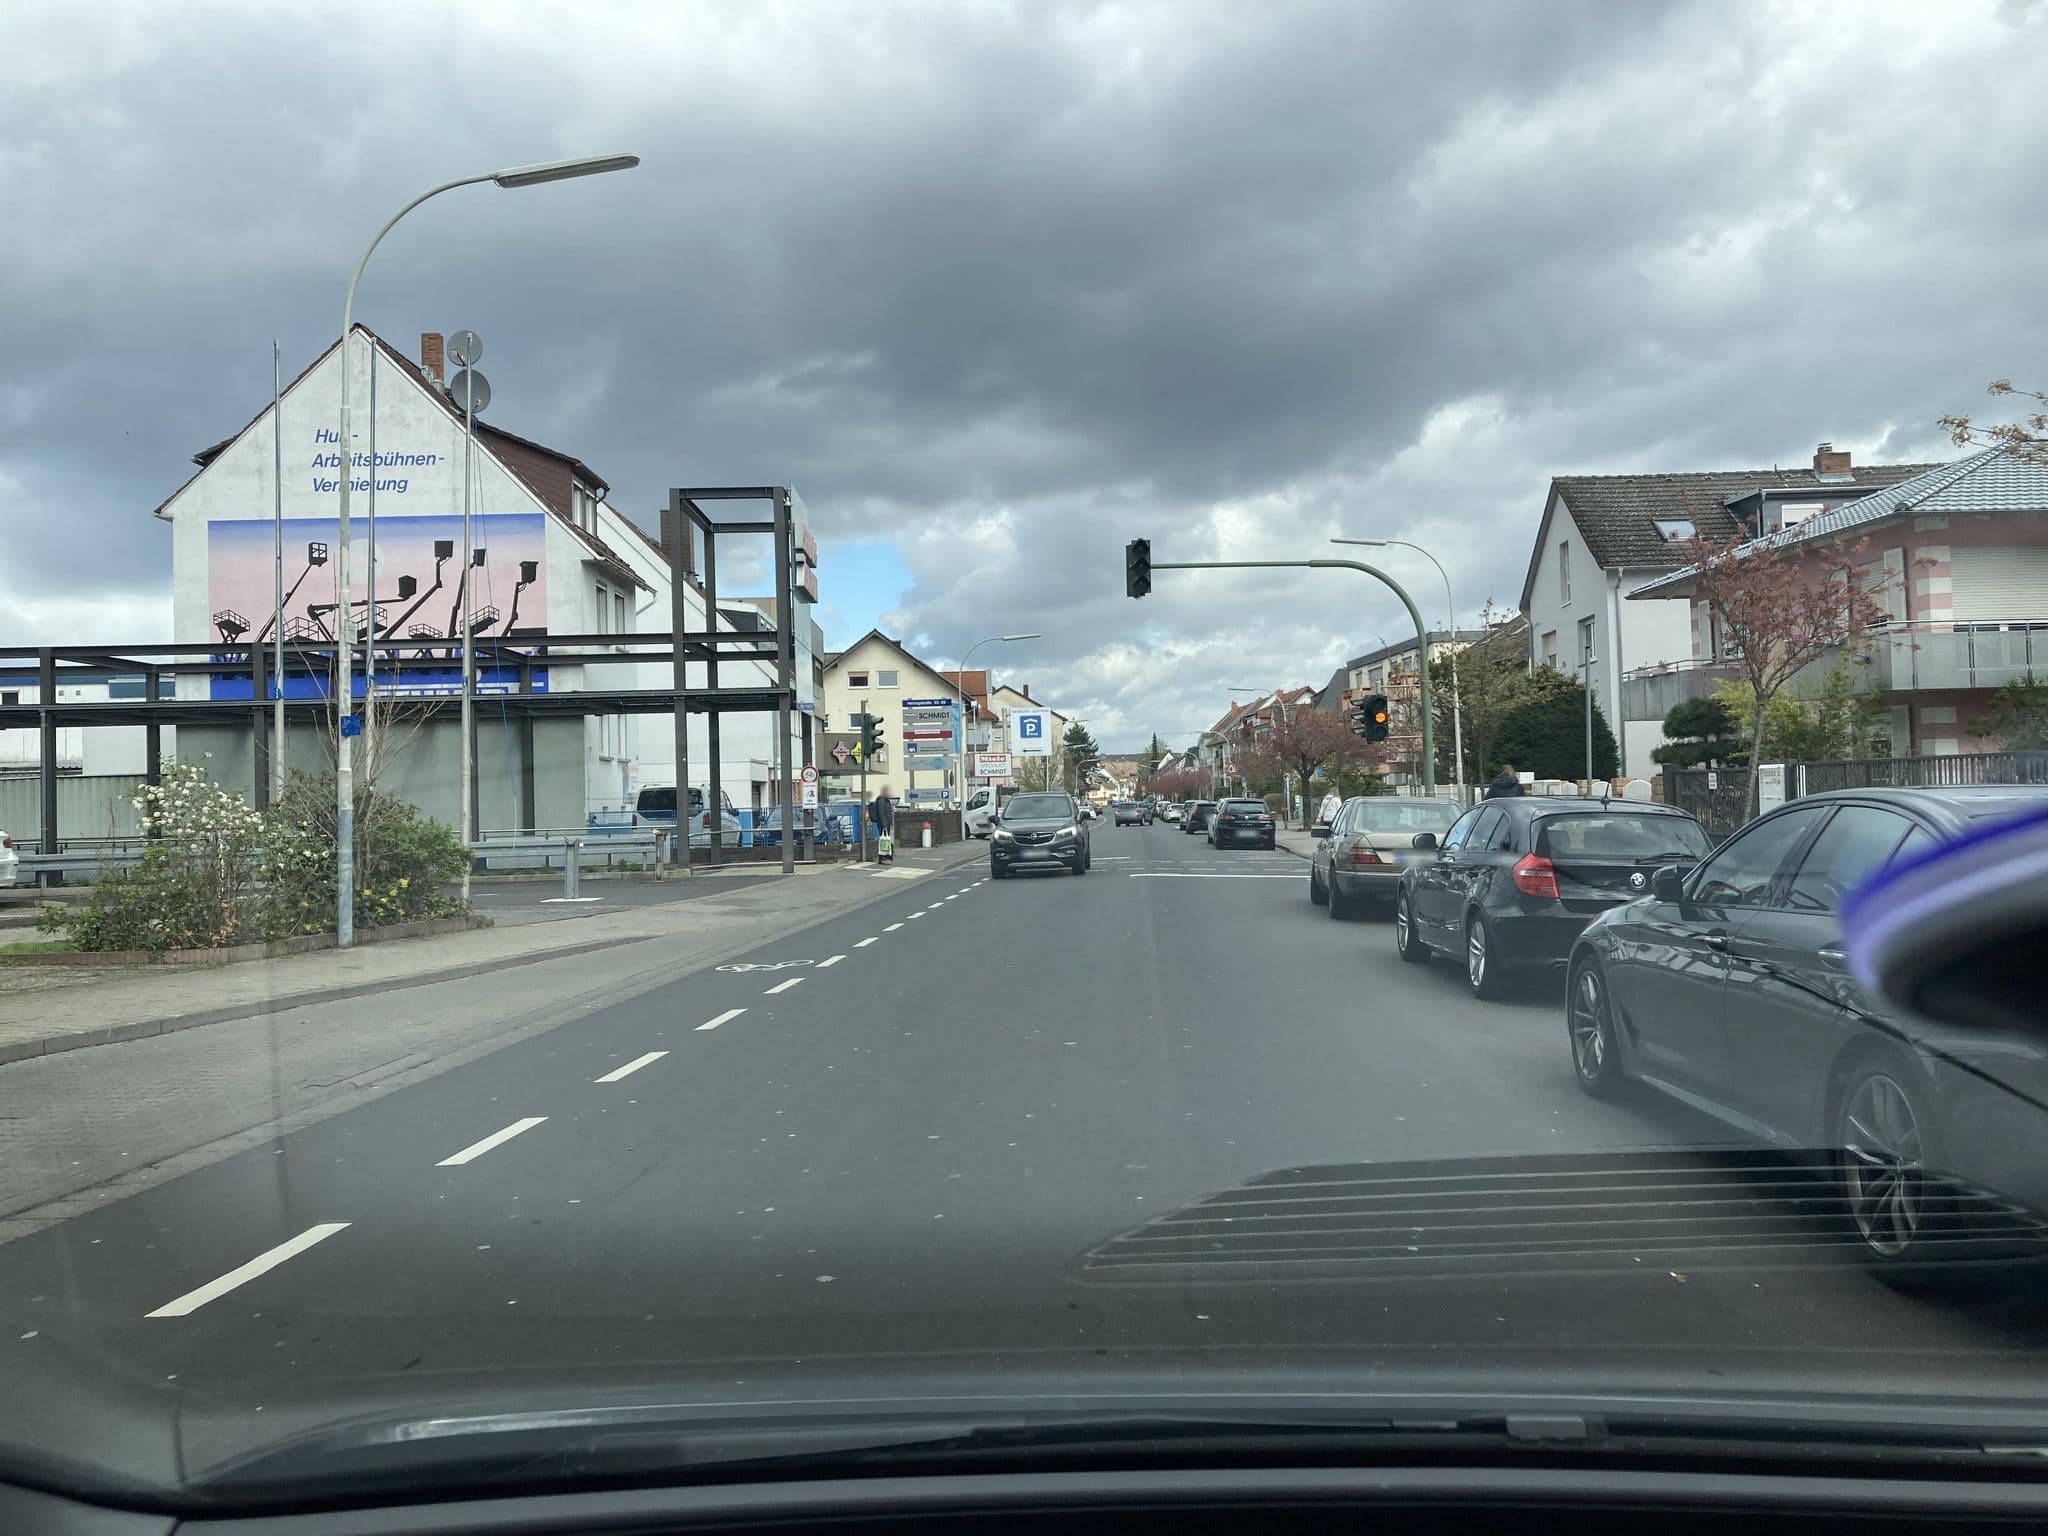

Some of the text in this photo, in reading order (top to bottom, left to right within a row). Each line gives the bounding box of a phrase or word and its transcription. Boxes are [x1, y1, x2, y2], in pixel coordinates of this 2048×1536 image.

[315, 429, 358, 443] Hu-
[312, 452, 445, 468] Arbitsbühnen-
[313, 477, 408, 493] Verieung
[918, 712, 950, 720] SCHMIDT
[1026, 723, 1036, 736] P
